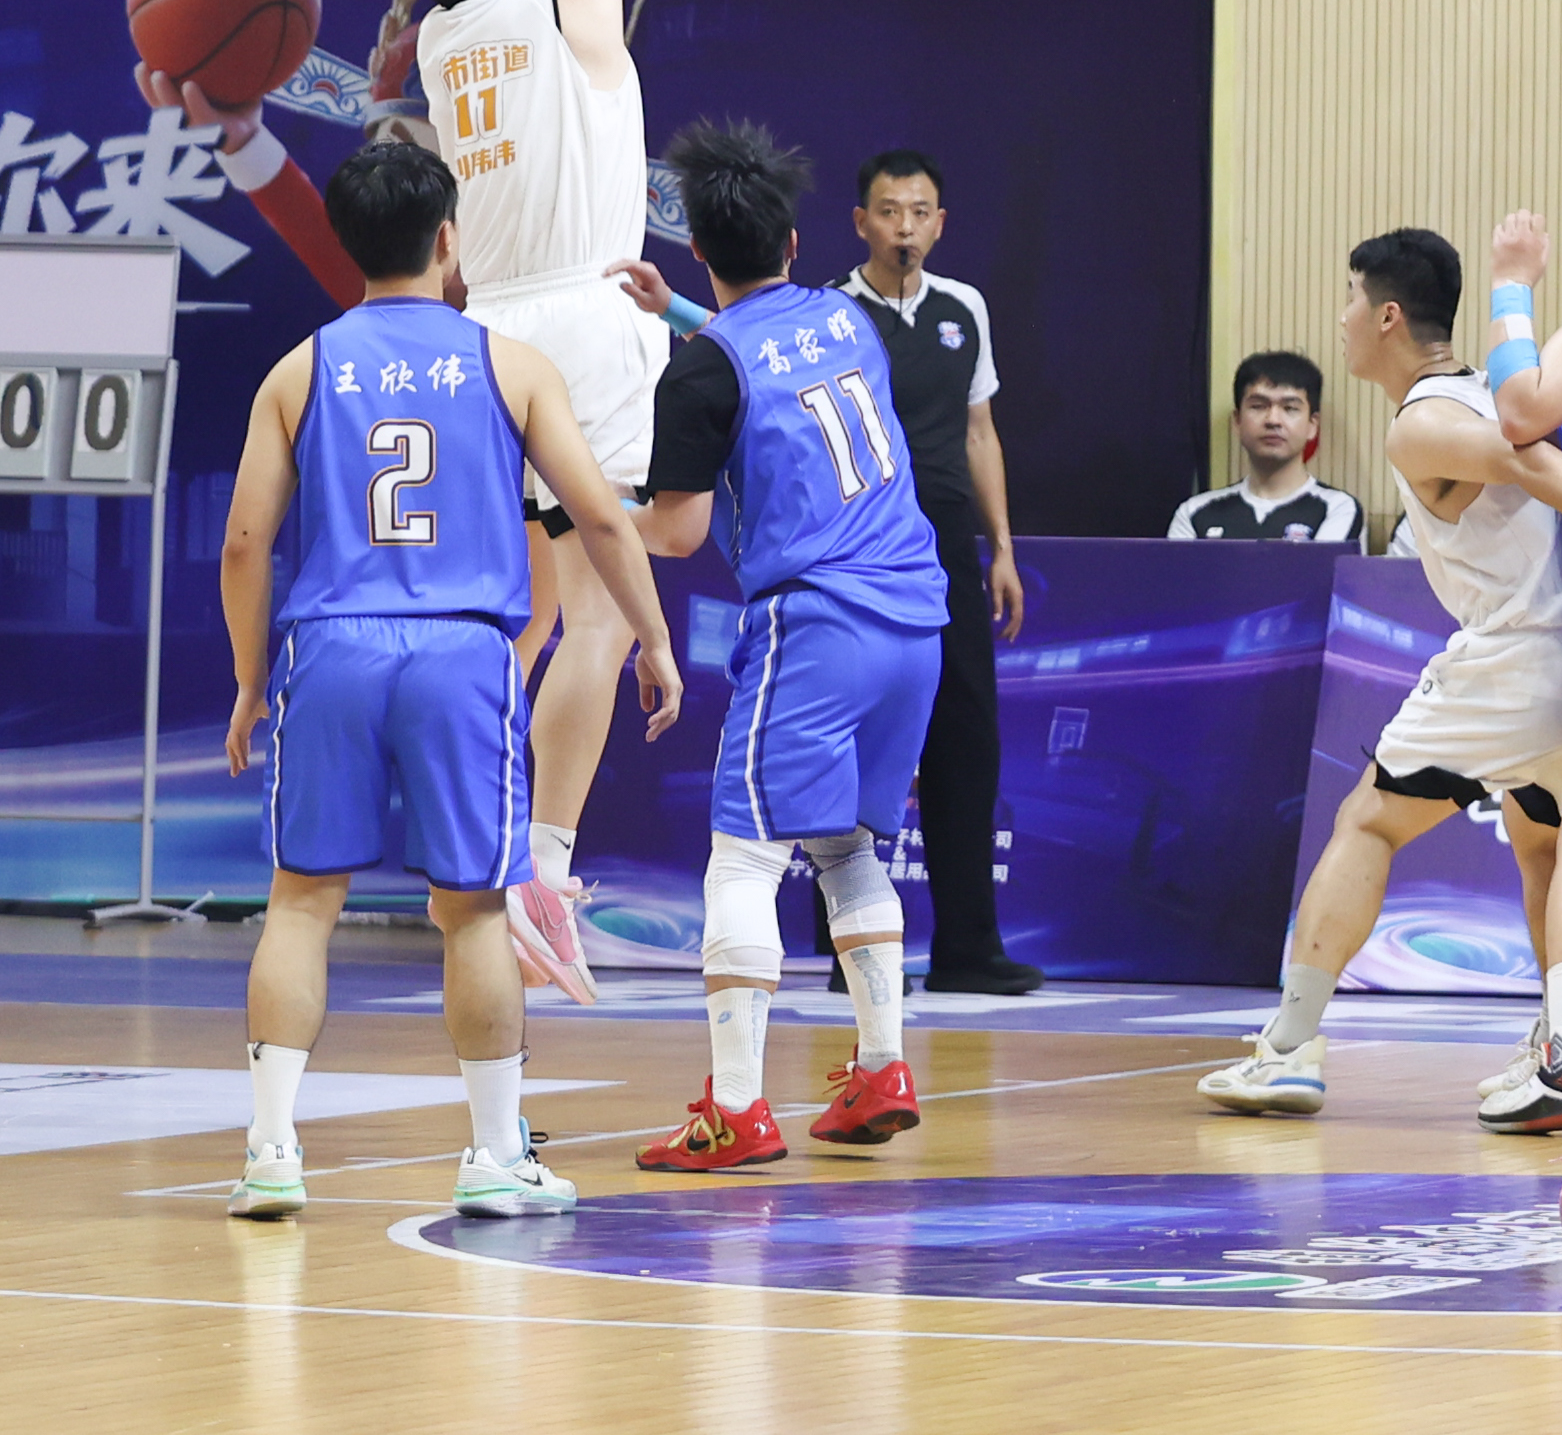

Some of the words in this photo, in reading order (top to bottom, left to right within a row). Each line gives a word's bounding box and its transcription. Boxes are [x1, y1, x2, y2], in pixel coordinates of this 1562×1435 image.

[443, 44, 530, 93] 市街道
[454, 84, 498, 140] 11
[334, 352, 468, 399] 王欣伟
[796, 367, 898, 505] 11
[366, 417, 438, 547] 2
